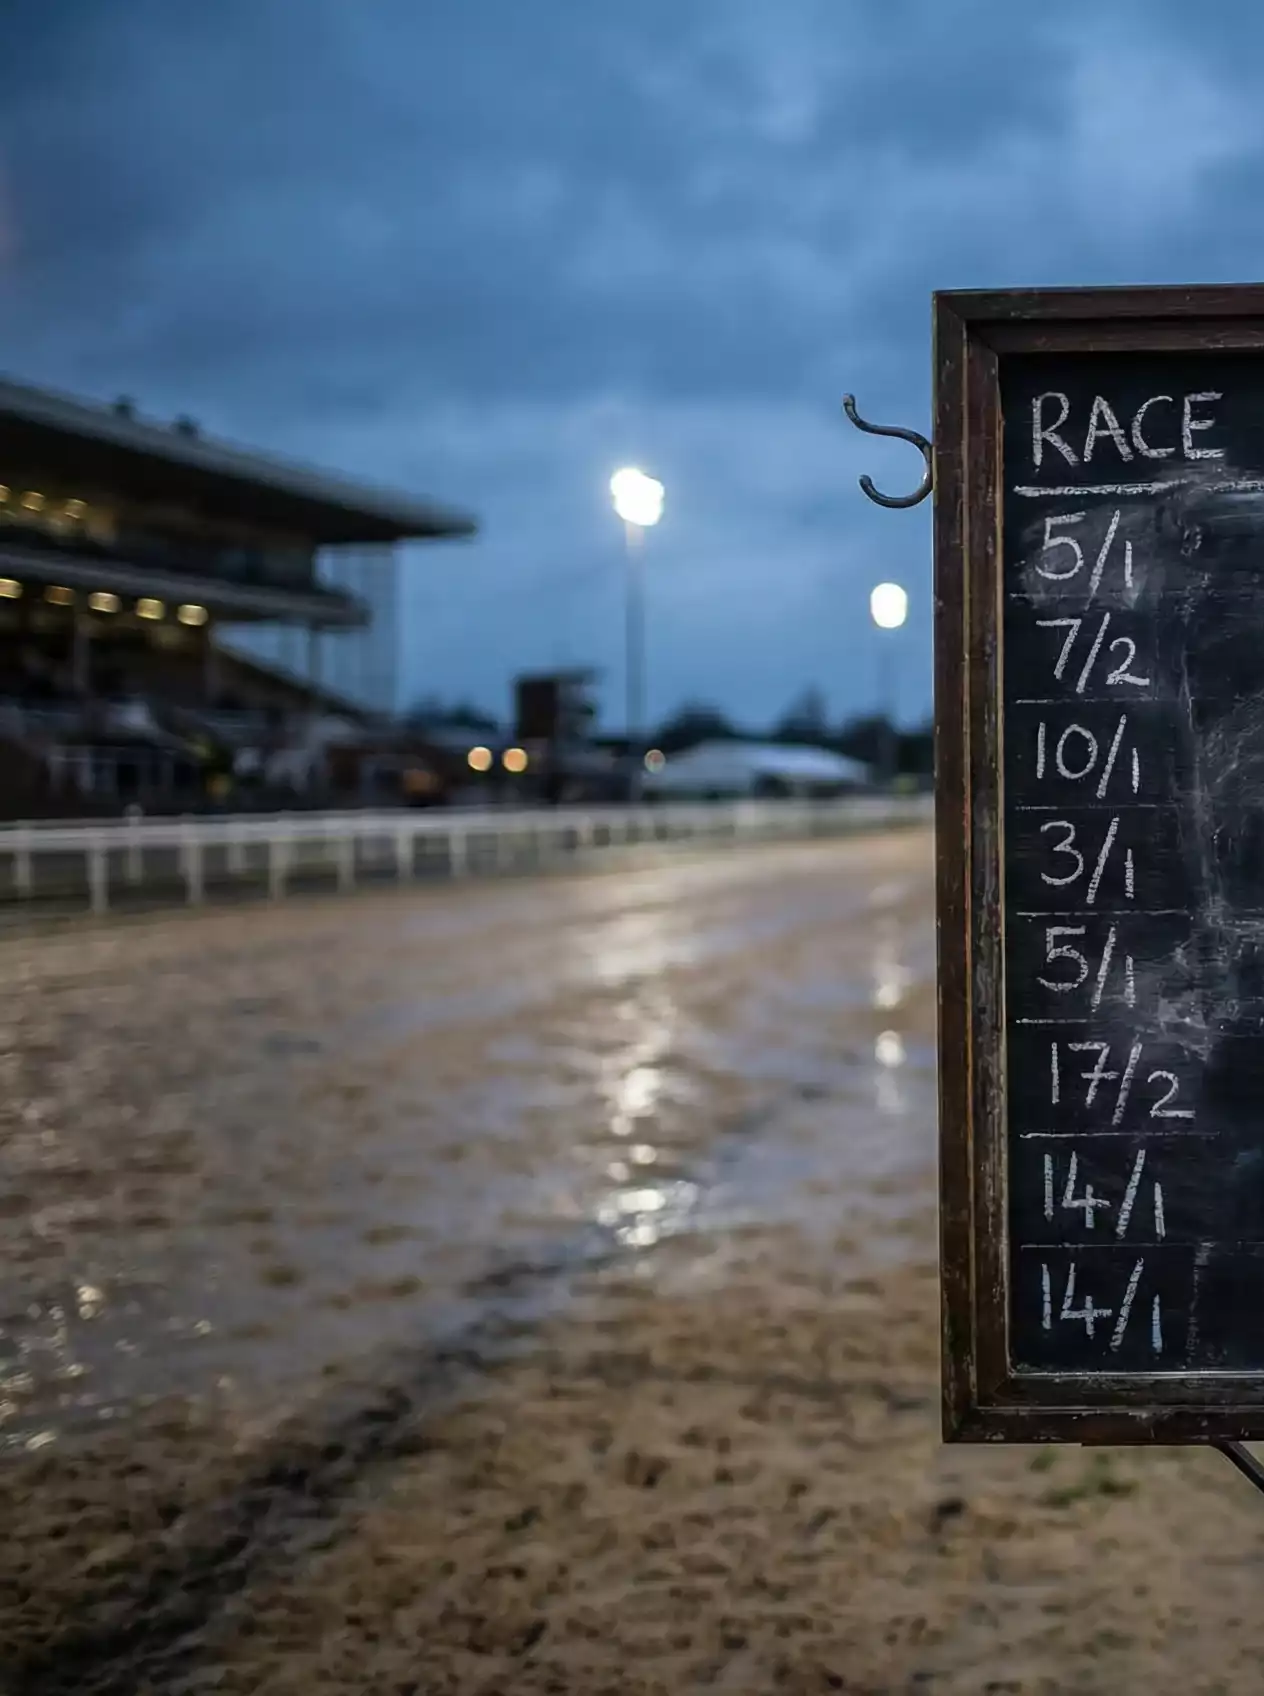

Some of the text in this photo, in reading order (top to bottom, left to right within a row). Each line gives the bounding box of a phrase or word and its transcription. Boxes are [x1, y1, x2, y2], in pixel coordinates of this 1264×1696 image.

[1031, 391, 1224, 467] RACE
[1035, 509, 1134, 609] 5/1
[1035, 611, 1150, 694] 7/2
[1037, 714, 1141, 799] 10/1
[1040, 816, 1135, 904] 3/1
[1036, 924, 1135, 1012] 5/1
[1050, 1040, 1197, 1126] 17/2
[1043, 1149, 1167, 1242] 14/1
[1041, 1257, 1163, 1354] 14/1
